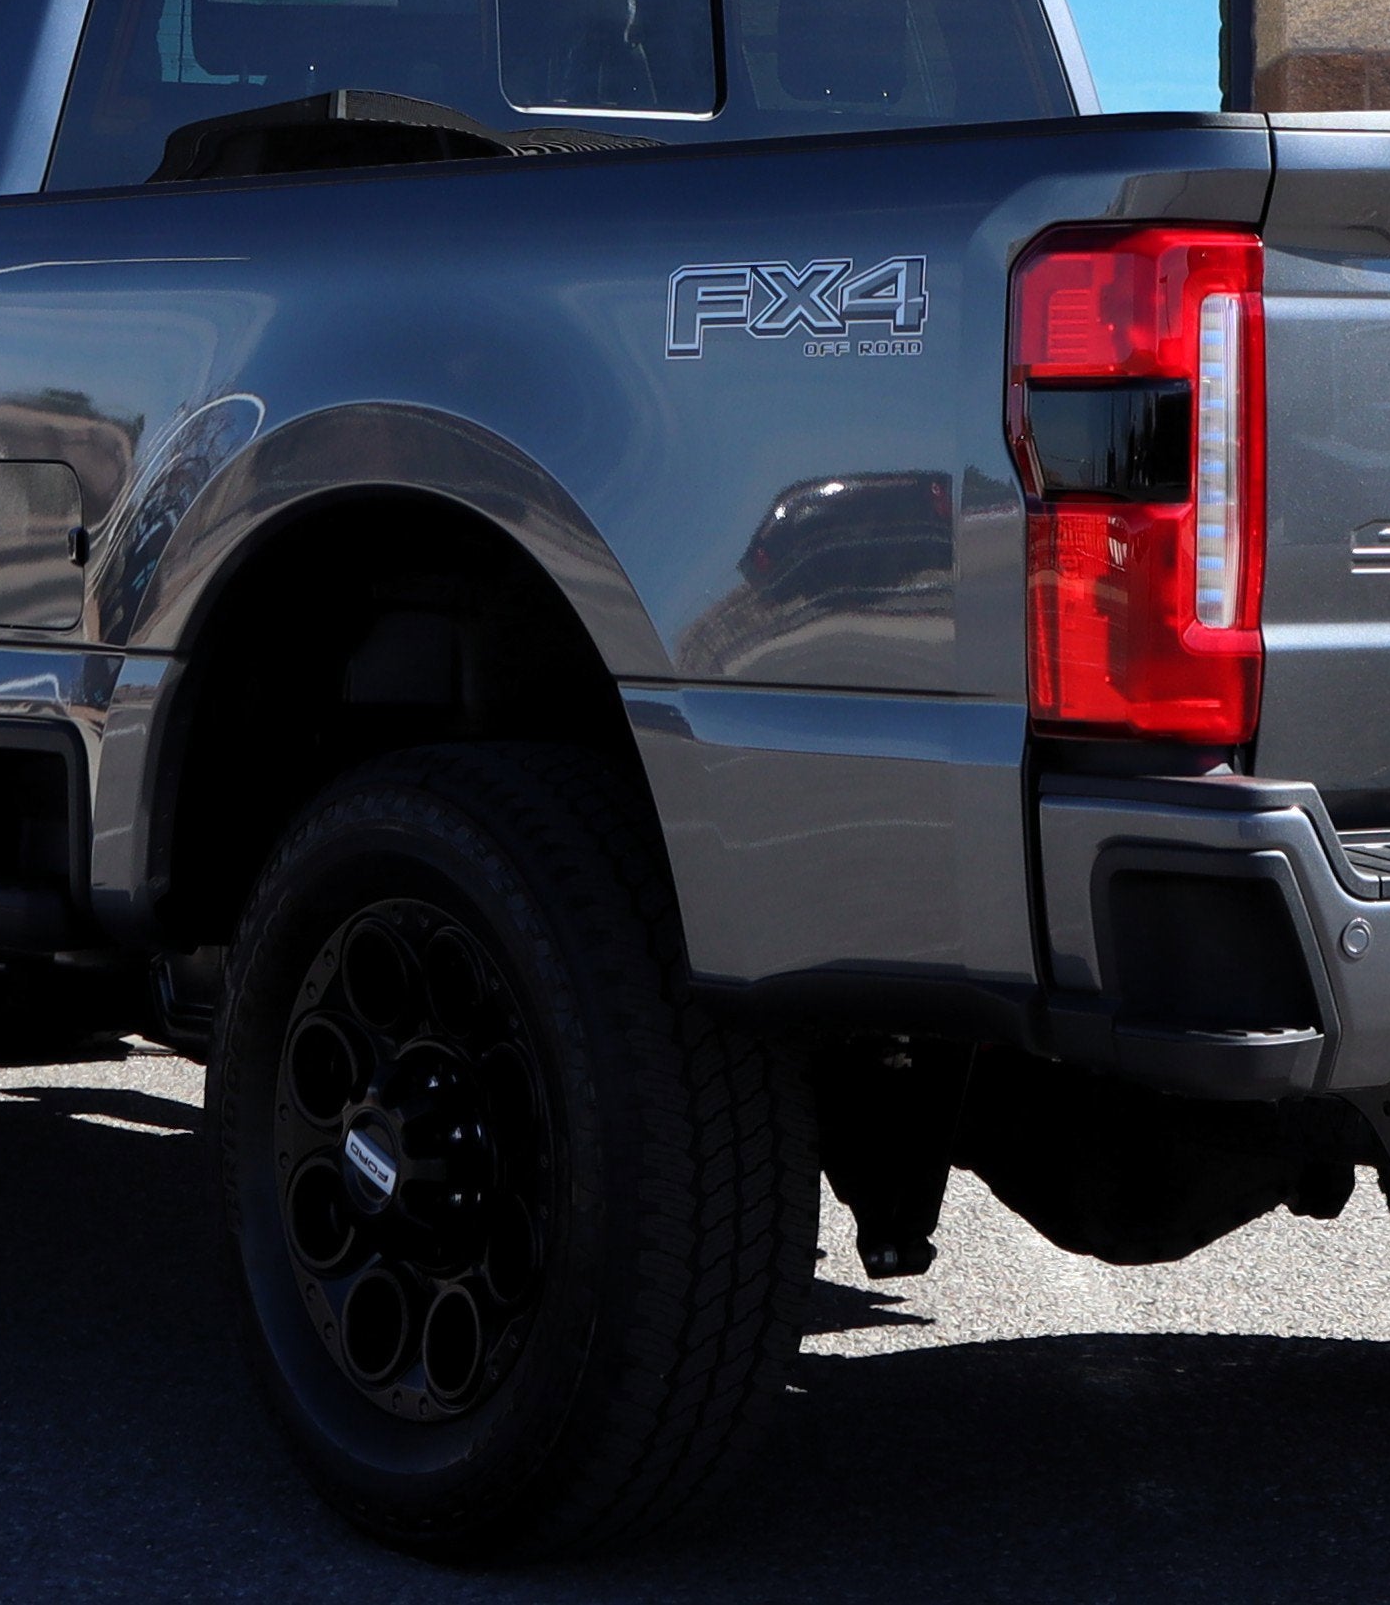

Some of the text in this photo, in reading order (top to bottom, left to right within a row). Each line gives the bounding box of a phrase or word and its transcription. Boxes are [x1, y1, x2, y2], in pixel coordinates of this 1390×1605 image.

[665, 254, 929, 360] FX4
[803, 340, 924, 357] OFF ROAD
[349, 1141, 389, 1184] FORD
